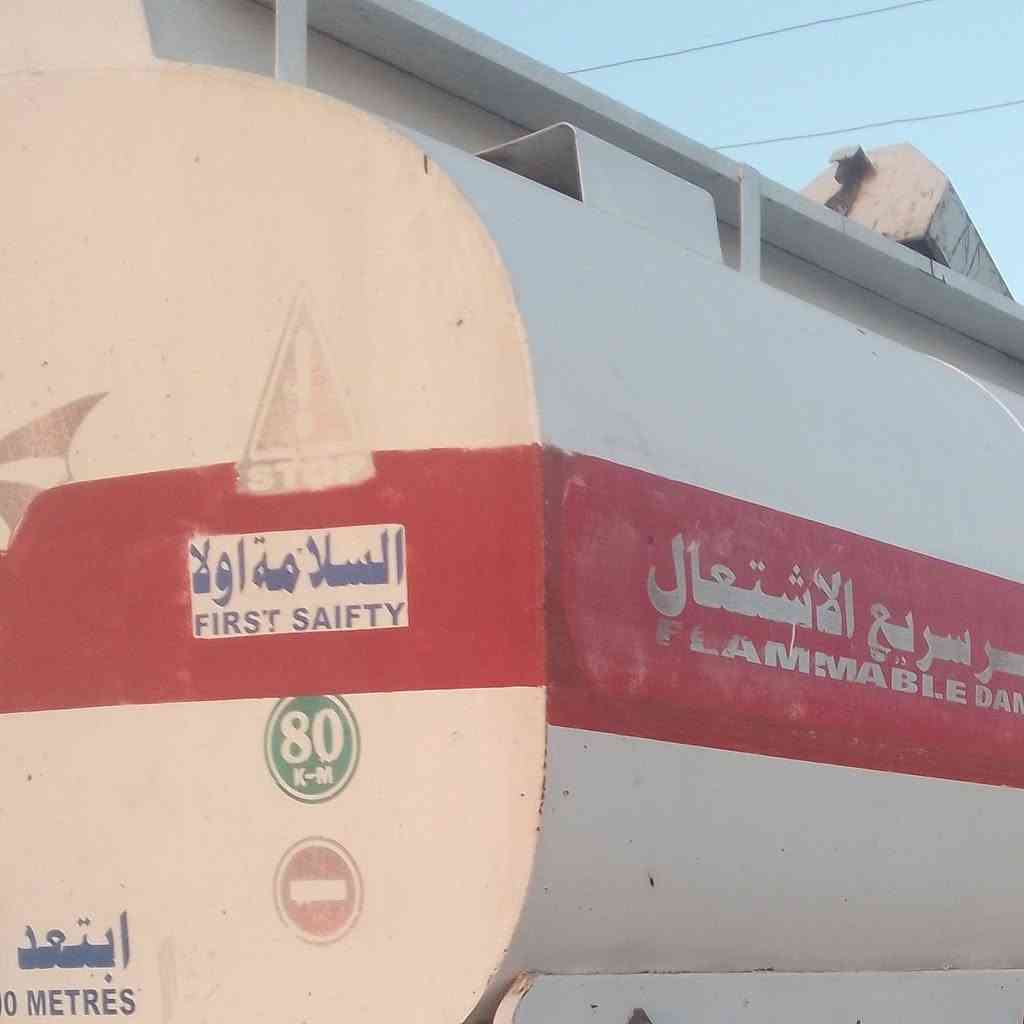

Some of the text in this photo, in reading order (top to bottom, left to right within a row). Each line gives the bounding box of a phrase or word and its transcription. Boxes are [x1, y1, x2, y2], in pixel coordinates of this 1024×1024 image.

[252, 527, 404, 593] السلامة
[647, 532, 855, 640] الاشتعال
[195, 602, 404, 637] FIRST SAIFTY
[867, 603, 971, 673] سريع
[655, 619, 967, 704] FLAMMABLE
[280, 706, 344, 764] 80
[293, 765, 334, 787] K-M
[17, 909, 130, 983] ابتعد
[0, 988, 136, 1016] 0 METRES
